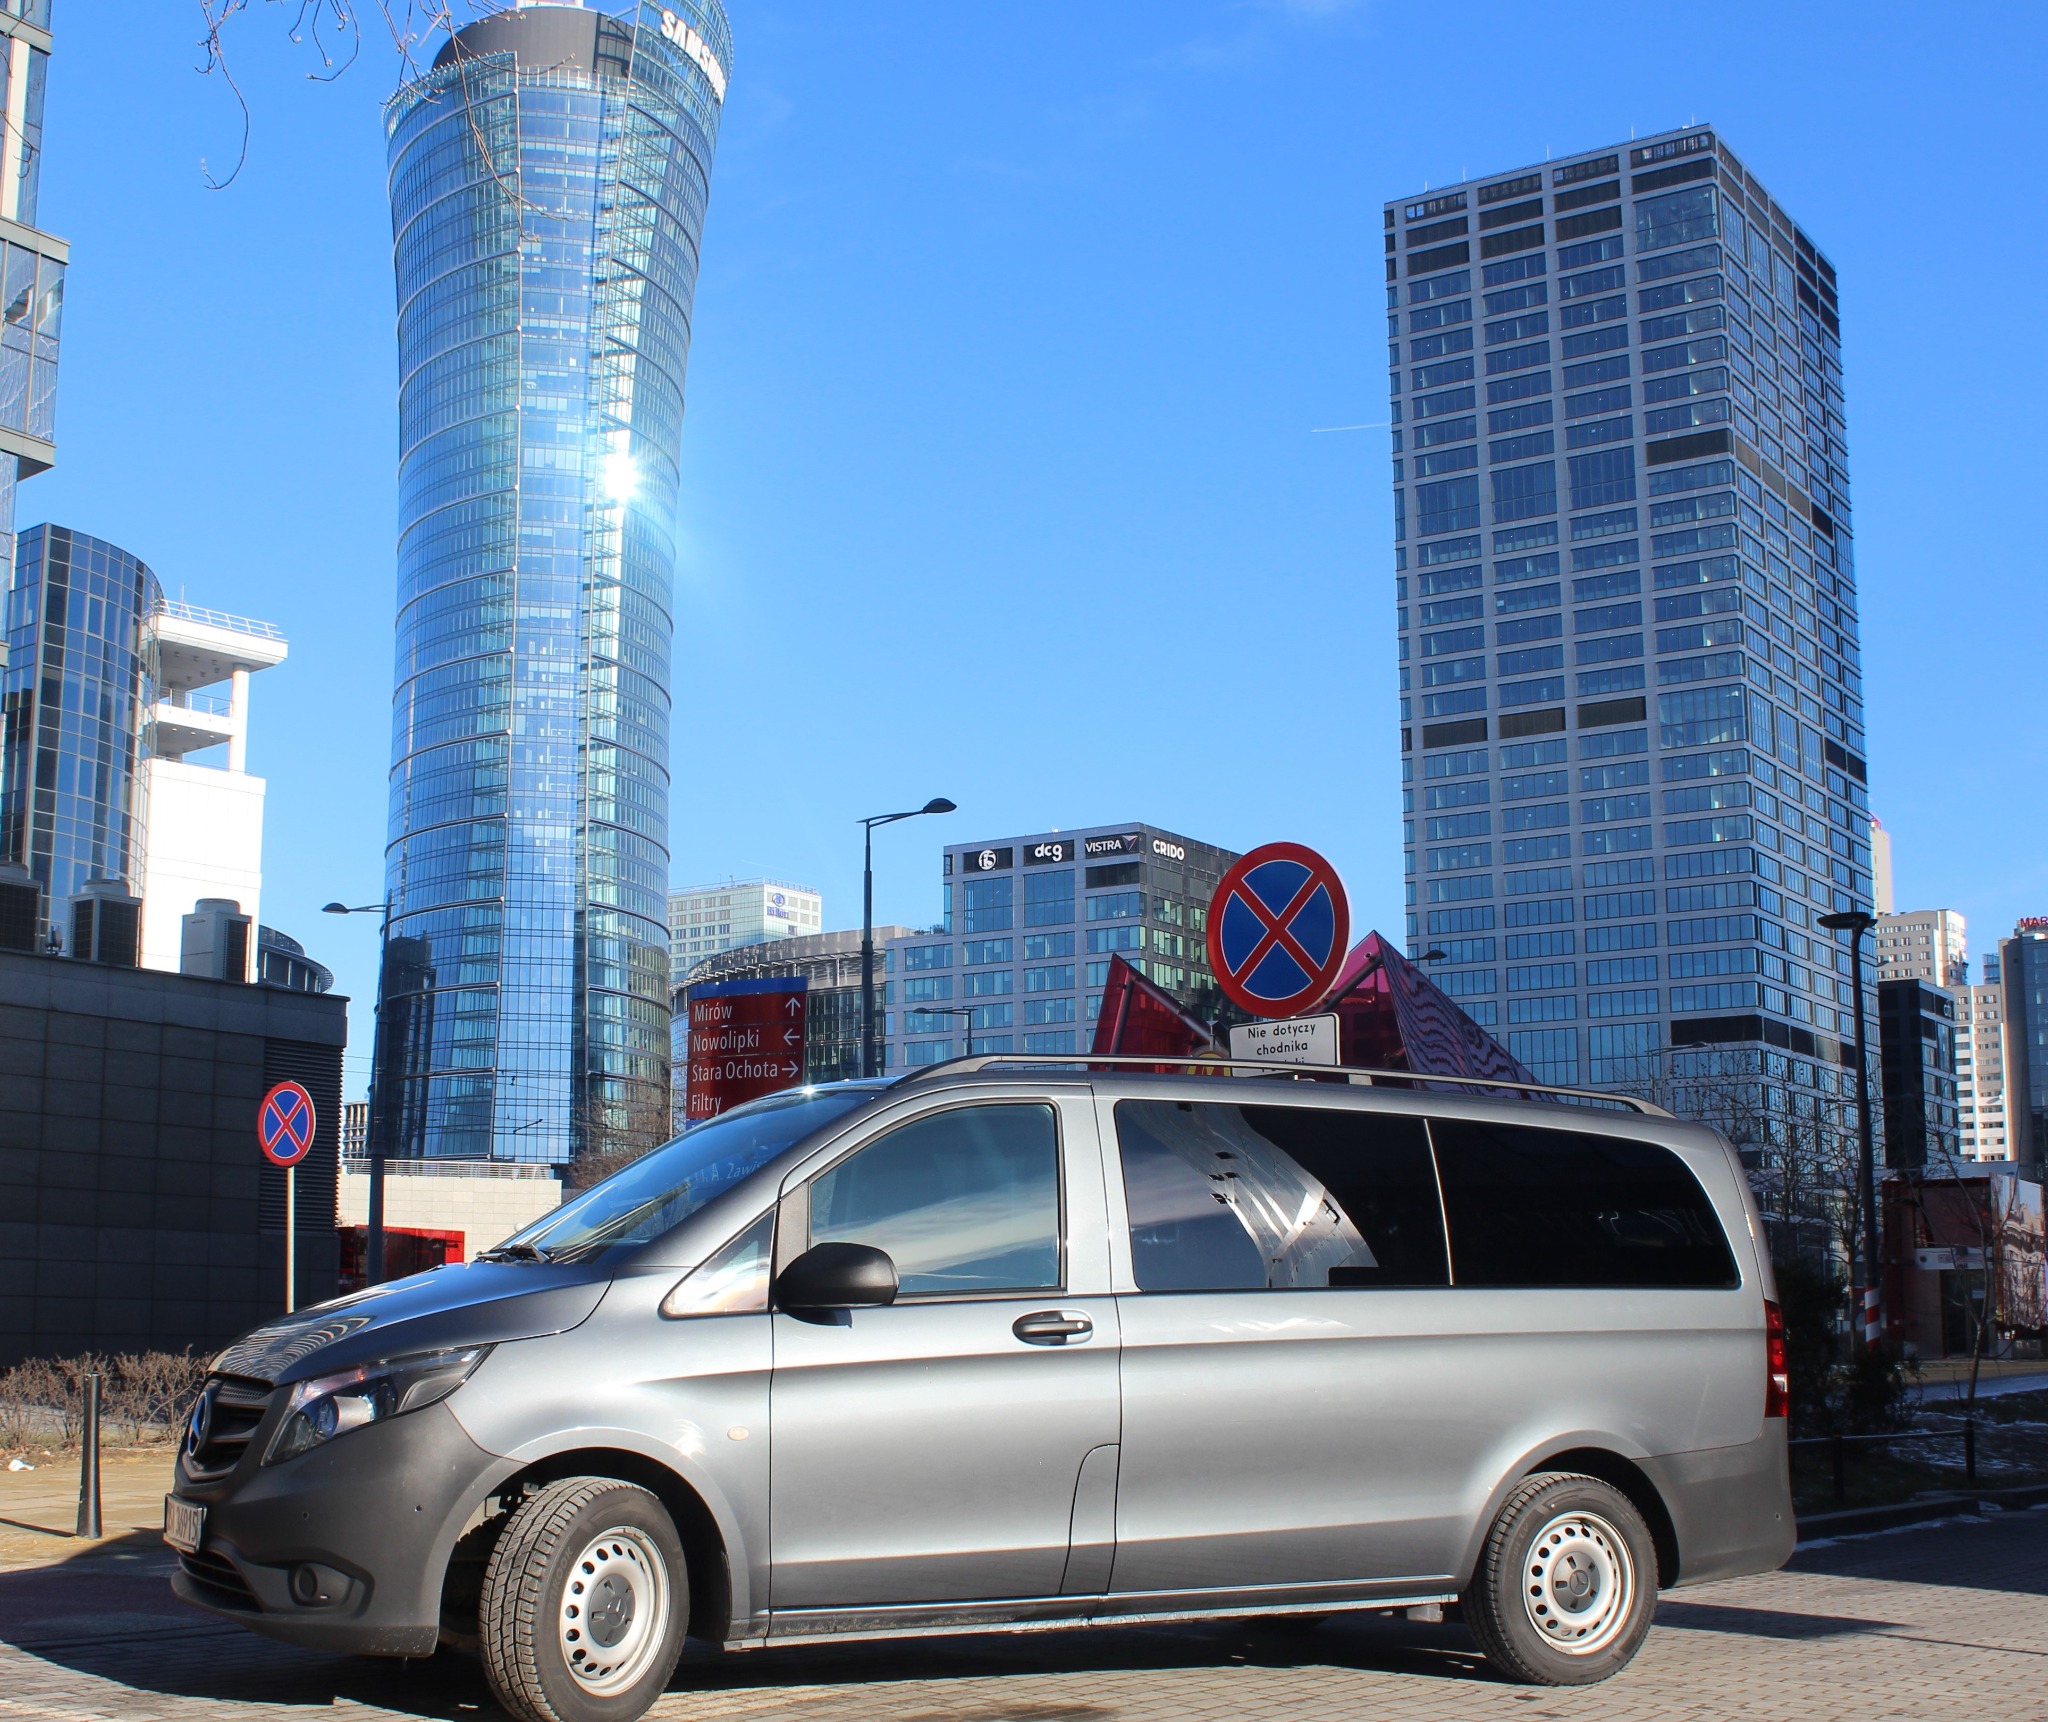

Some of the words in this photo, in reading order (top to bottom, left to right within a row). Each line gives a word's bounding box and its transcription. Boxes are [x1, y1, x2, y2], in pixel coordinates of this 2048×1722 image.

[1034, 843, 1063, 862] dcg
[1085, 839, 1122, 853] VISTRA
[1152, 839, 1185, 861] CRIDO
[979, 849, 997, 870] f5
[694, 1002, 733, 1022] Mirów
[693, 1029, 760, 1053] Nowolipki
[1247, 1027, 1267, 1039] Nie
[1272, 1023, 1316, 1037] dotyczy
[1256, 1040, 1308, 1056] chodnika
[692, 1064, 722, 1082] Stara
[725, 1059, 778, 1079] Ochota
[691, 1093, 722, 1117] Filtry
